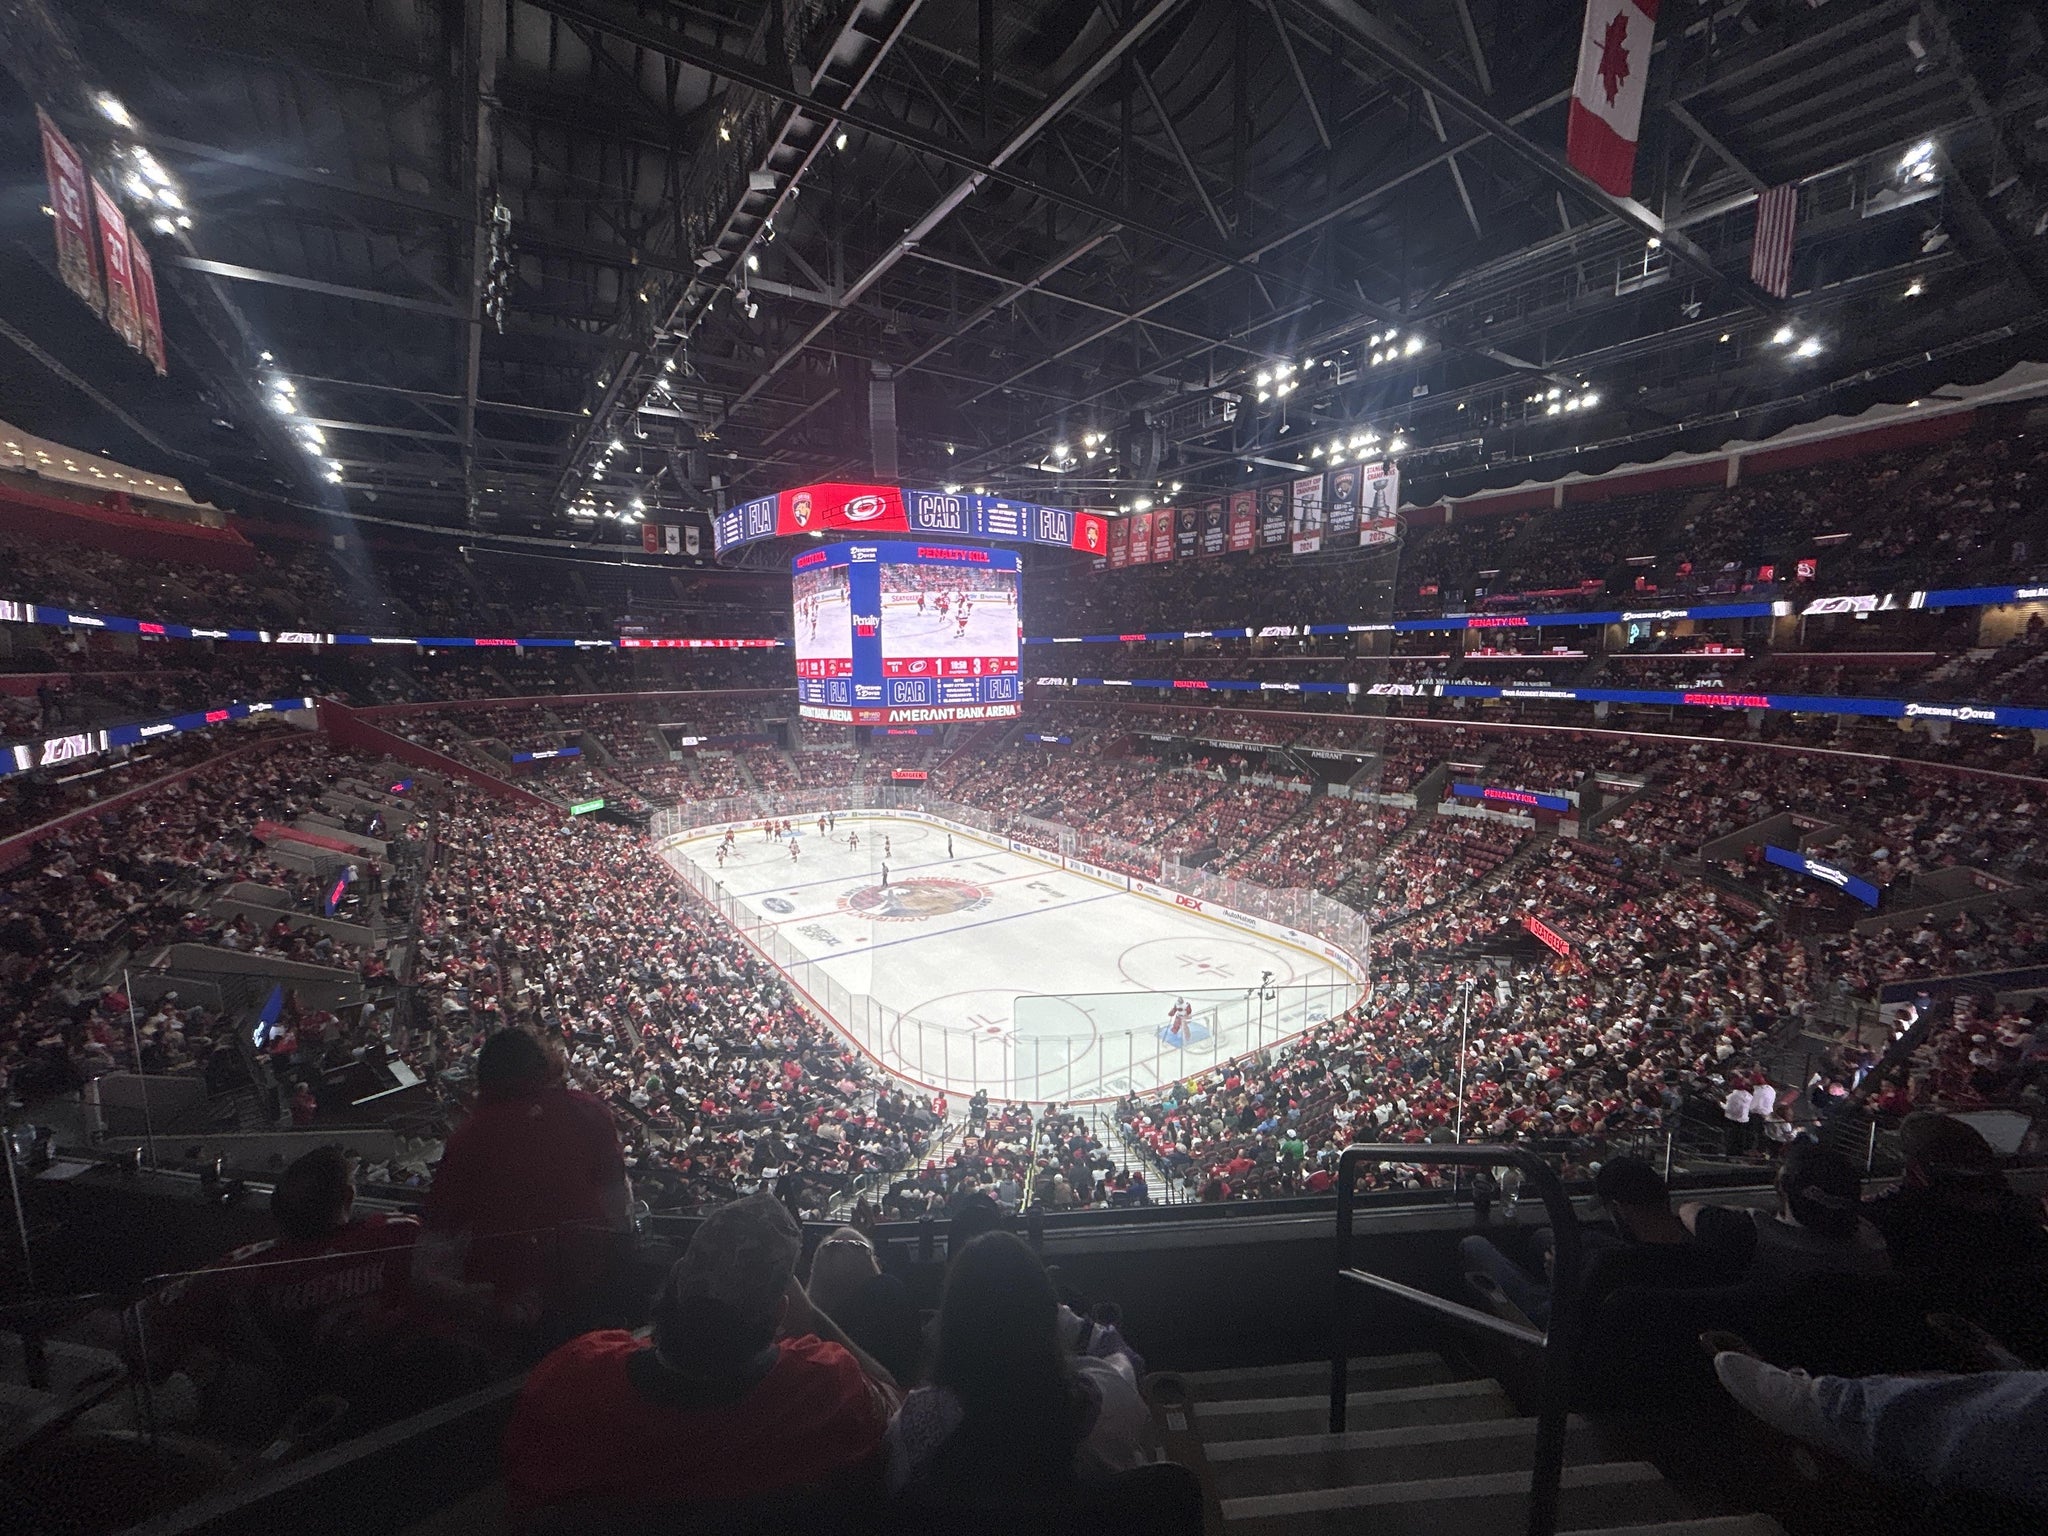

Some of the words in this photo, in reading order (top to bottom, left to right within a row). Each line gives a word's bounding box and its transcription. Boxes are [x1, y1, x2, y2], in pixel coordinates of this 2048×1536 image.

[749, 502, 771, 535] FLA
[919, 496, 960, 529] CAR
[1040, 510, 1067, 542] FLA
[1370, 531, 1386, 542] 2025
[918, 547, 968, 560] PENALTY
[969, 551, 990, 562] KILL
[853, 615, 880, 628] Penalty
[1468, 618, 1508, 627] PENALTY
[1509, 617, 1528, 626] KILL
[935, 658, 942, 675] 1
[972, 658, 981, 675] 3
[830, 682, 847, 702] FLA
[894, 681, 925, 702] CAR
[990, 679, 1011, 699] FLA
[1684, 694, 1743, 705] PENALTY
[1744, 696, 1770, 707] KILL
[830, 709, 853, 722] ARENA
[889, 708, 955, 722] AMERANT
[956, 706, 985, 719] BANK
[986, 705, 1016, 717] ARENA
[1959, 706, 1995, 720] DOVER
[1219, 742, 1243, 750] AMERANT
[1312, 751, 1343, 760] AMERANT
[1484, 788, 1520, 801] PENALTY
[1521, 794, 1538, 805] KILL
[1175, 895, 1203, 912] DEX
[1224, 909, 1257, 925] AutoNation
[1534, 921, 1565, 954] SEATGEEK
